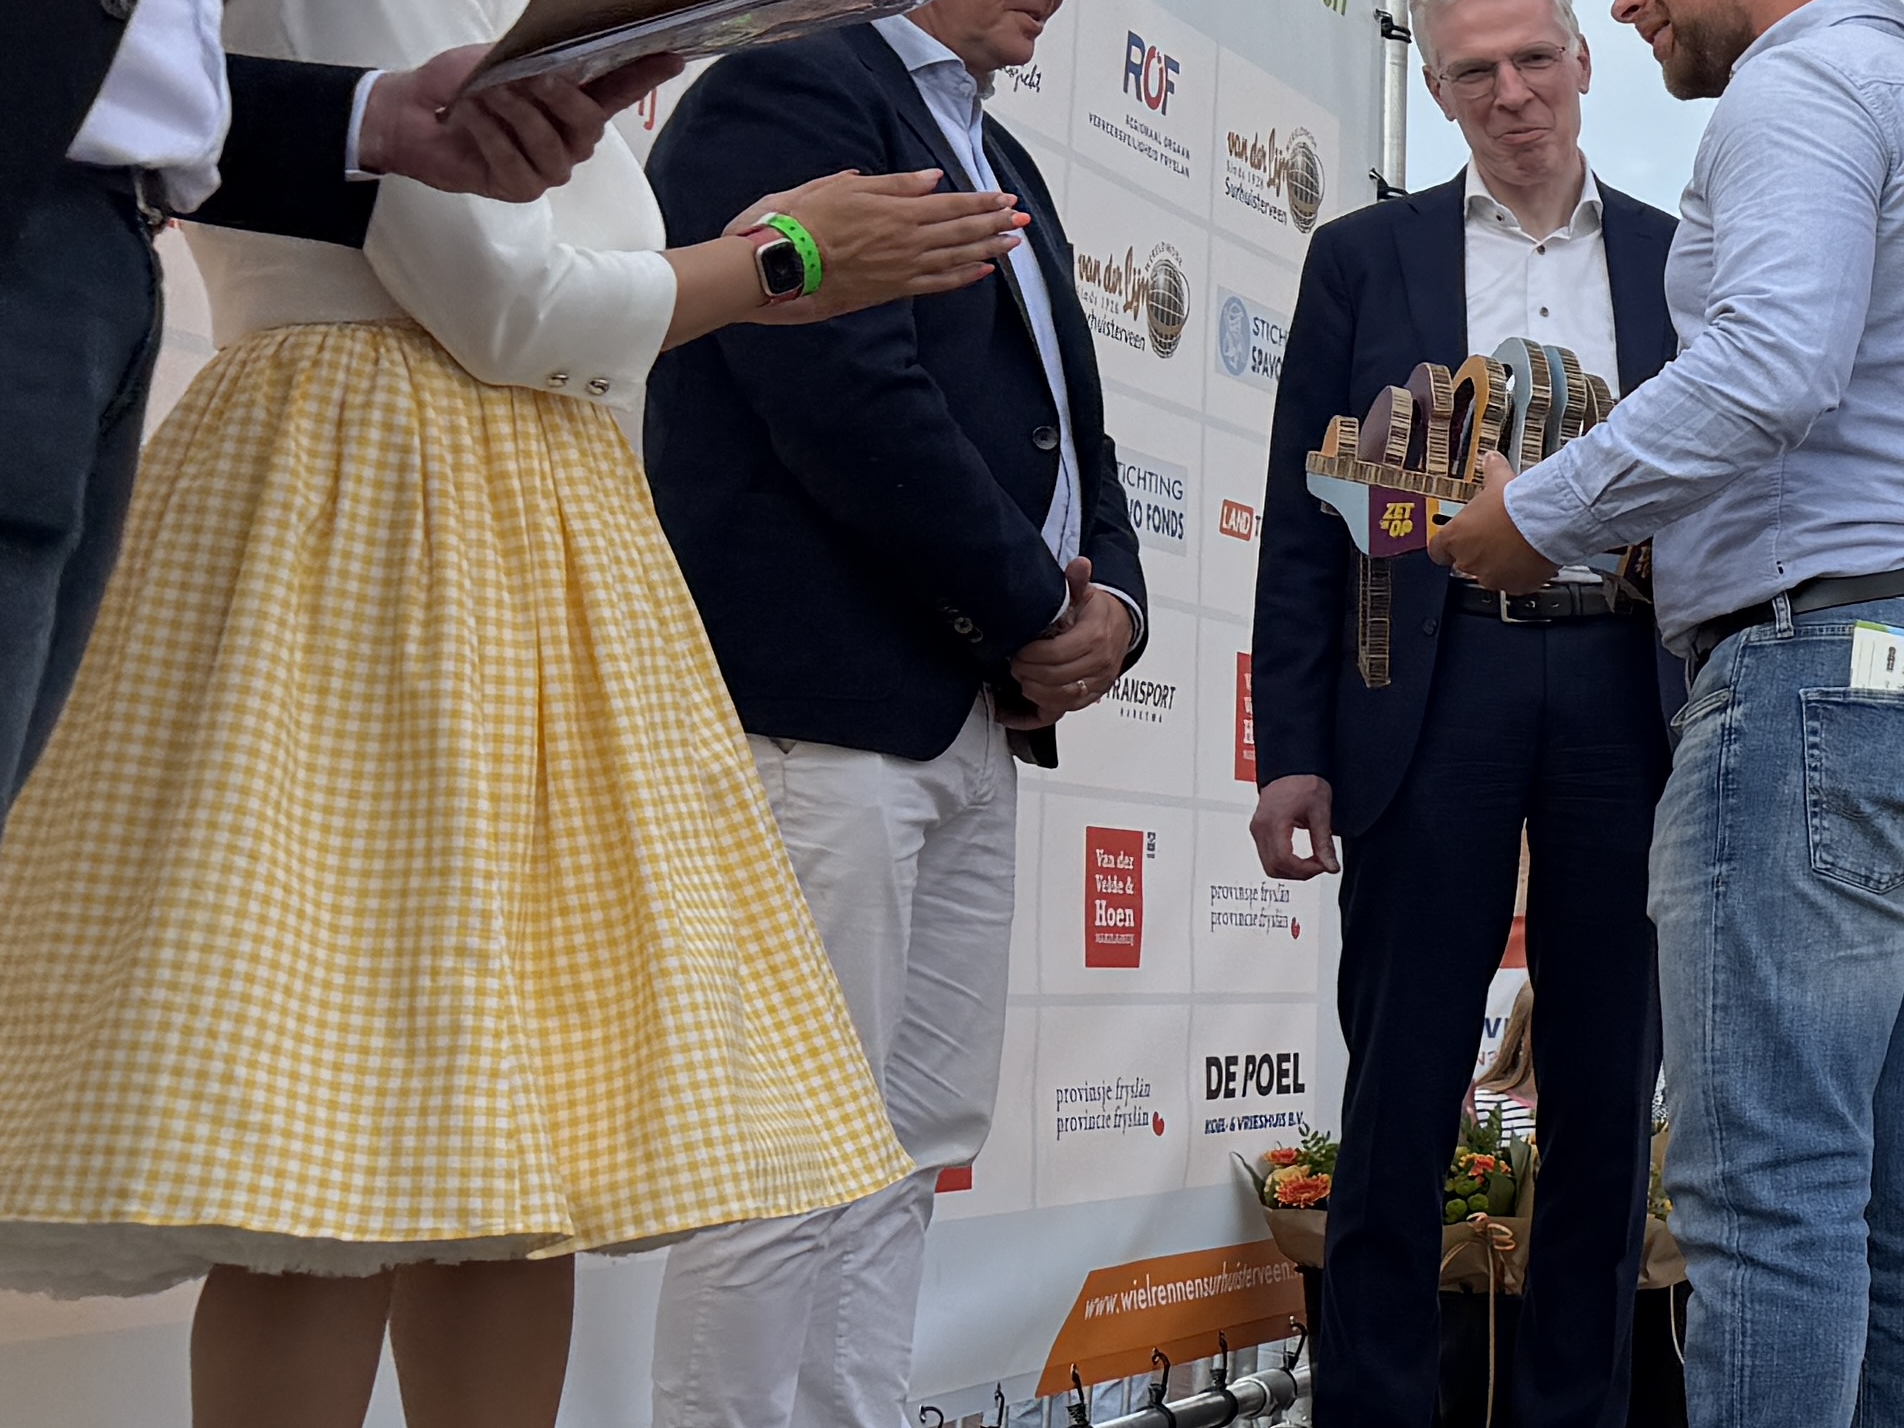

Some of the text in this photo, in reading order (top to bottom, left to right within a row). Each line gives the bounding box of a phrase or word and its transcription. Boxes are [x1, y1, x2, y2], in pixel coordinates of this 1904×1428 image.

[1146, 502, 1185, 540] FONDS
[1222, 507, 1251, 535] LAND
[1095, 848, 1114, 869] Van
[1094, 899, 1135, 927] Hoen
[1205, 1052, 1305, 1100] DE POEL
[1056, 1080, 1113, 1112] provinsje
[1056, 1108, 1112, 1141] provincie
